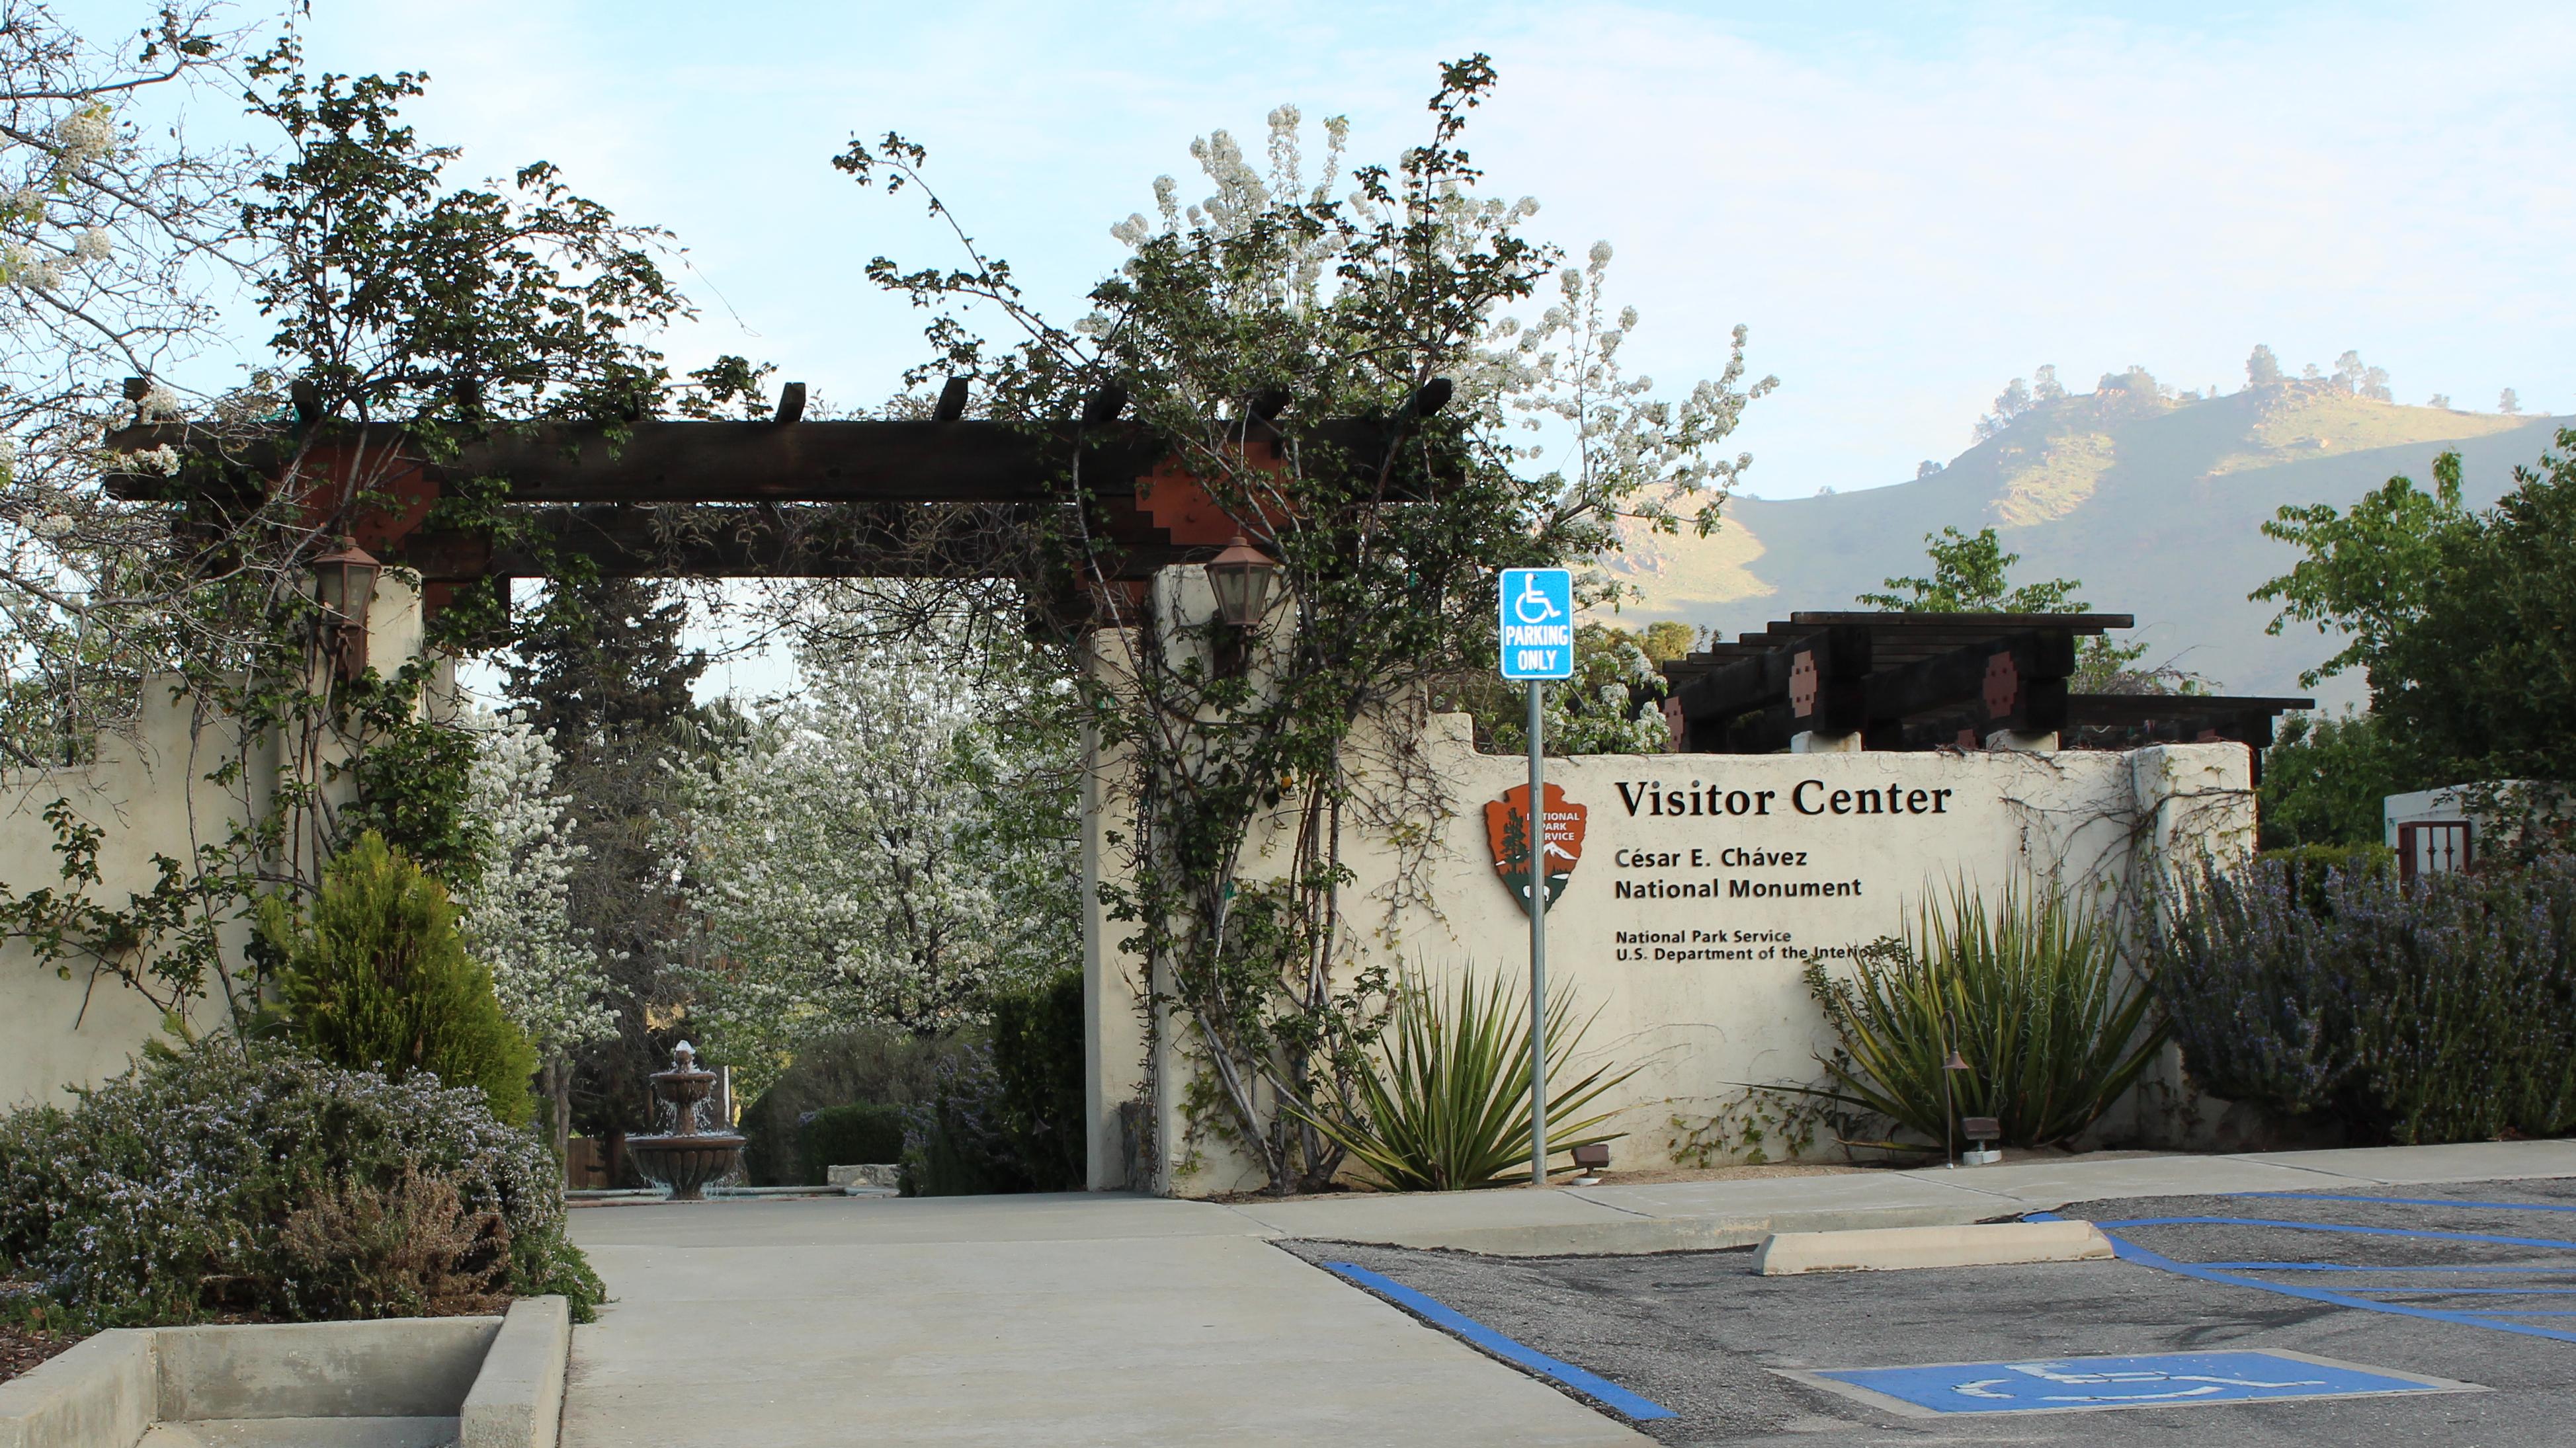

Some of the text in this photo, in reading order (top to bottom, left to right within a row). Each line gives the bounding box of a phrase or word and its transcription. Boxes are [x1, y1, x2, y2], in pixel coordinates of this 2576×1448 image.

[1505, 625, 1568, 646] PARKING
[1518, 650, 1557, 670] ONLY
[1614, 780, 1952, 817] Visitor Center
[1615, 847, 1807, 867] César E. Chávez
[1615, 878, 1862, 899] National Monument
[1616, 930, 1792, 944] National Park Service
[1616, 945, 1870, 963] U.S. Department of the Interio
